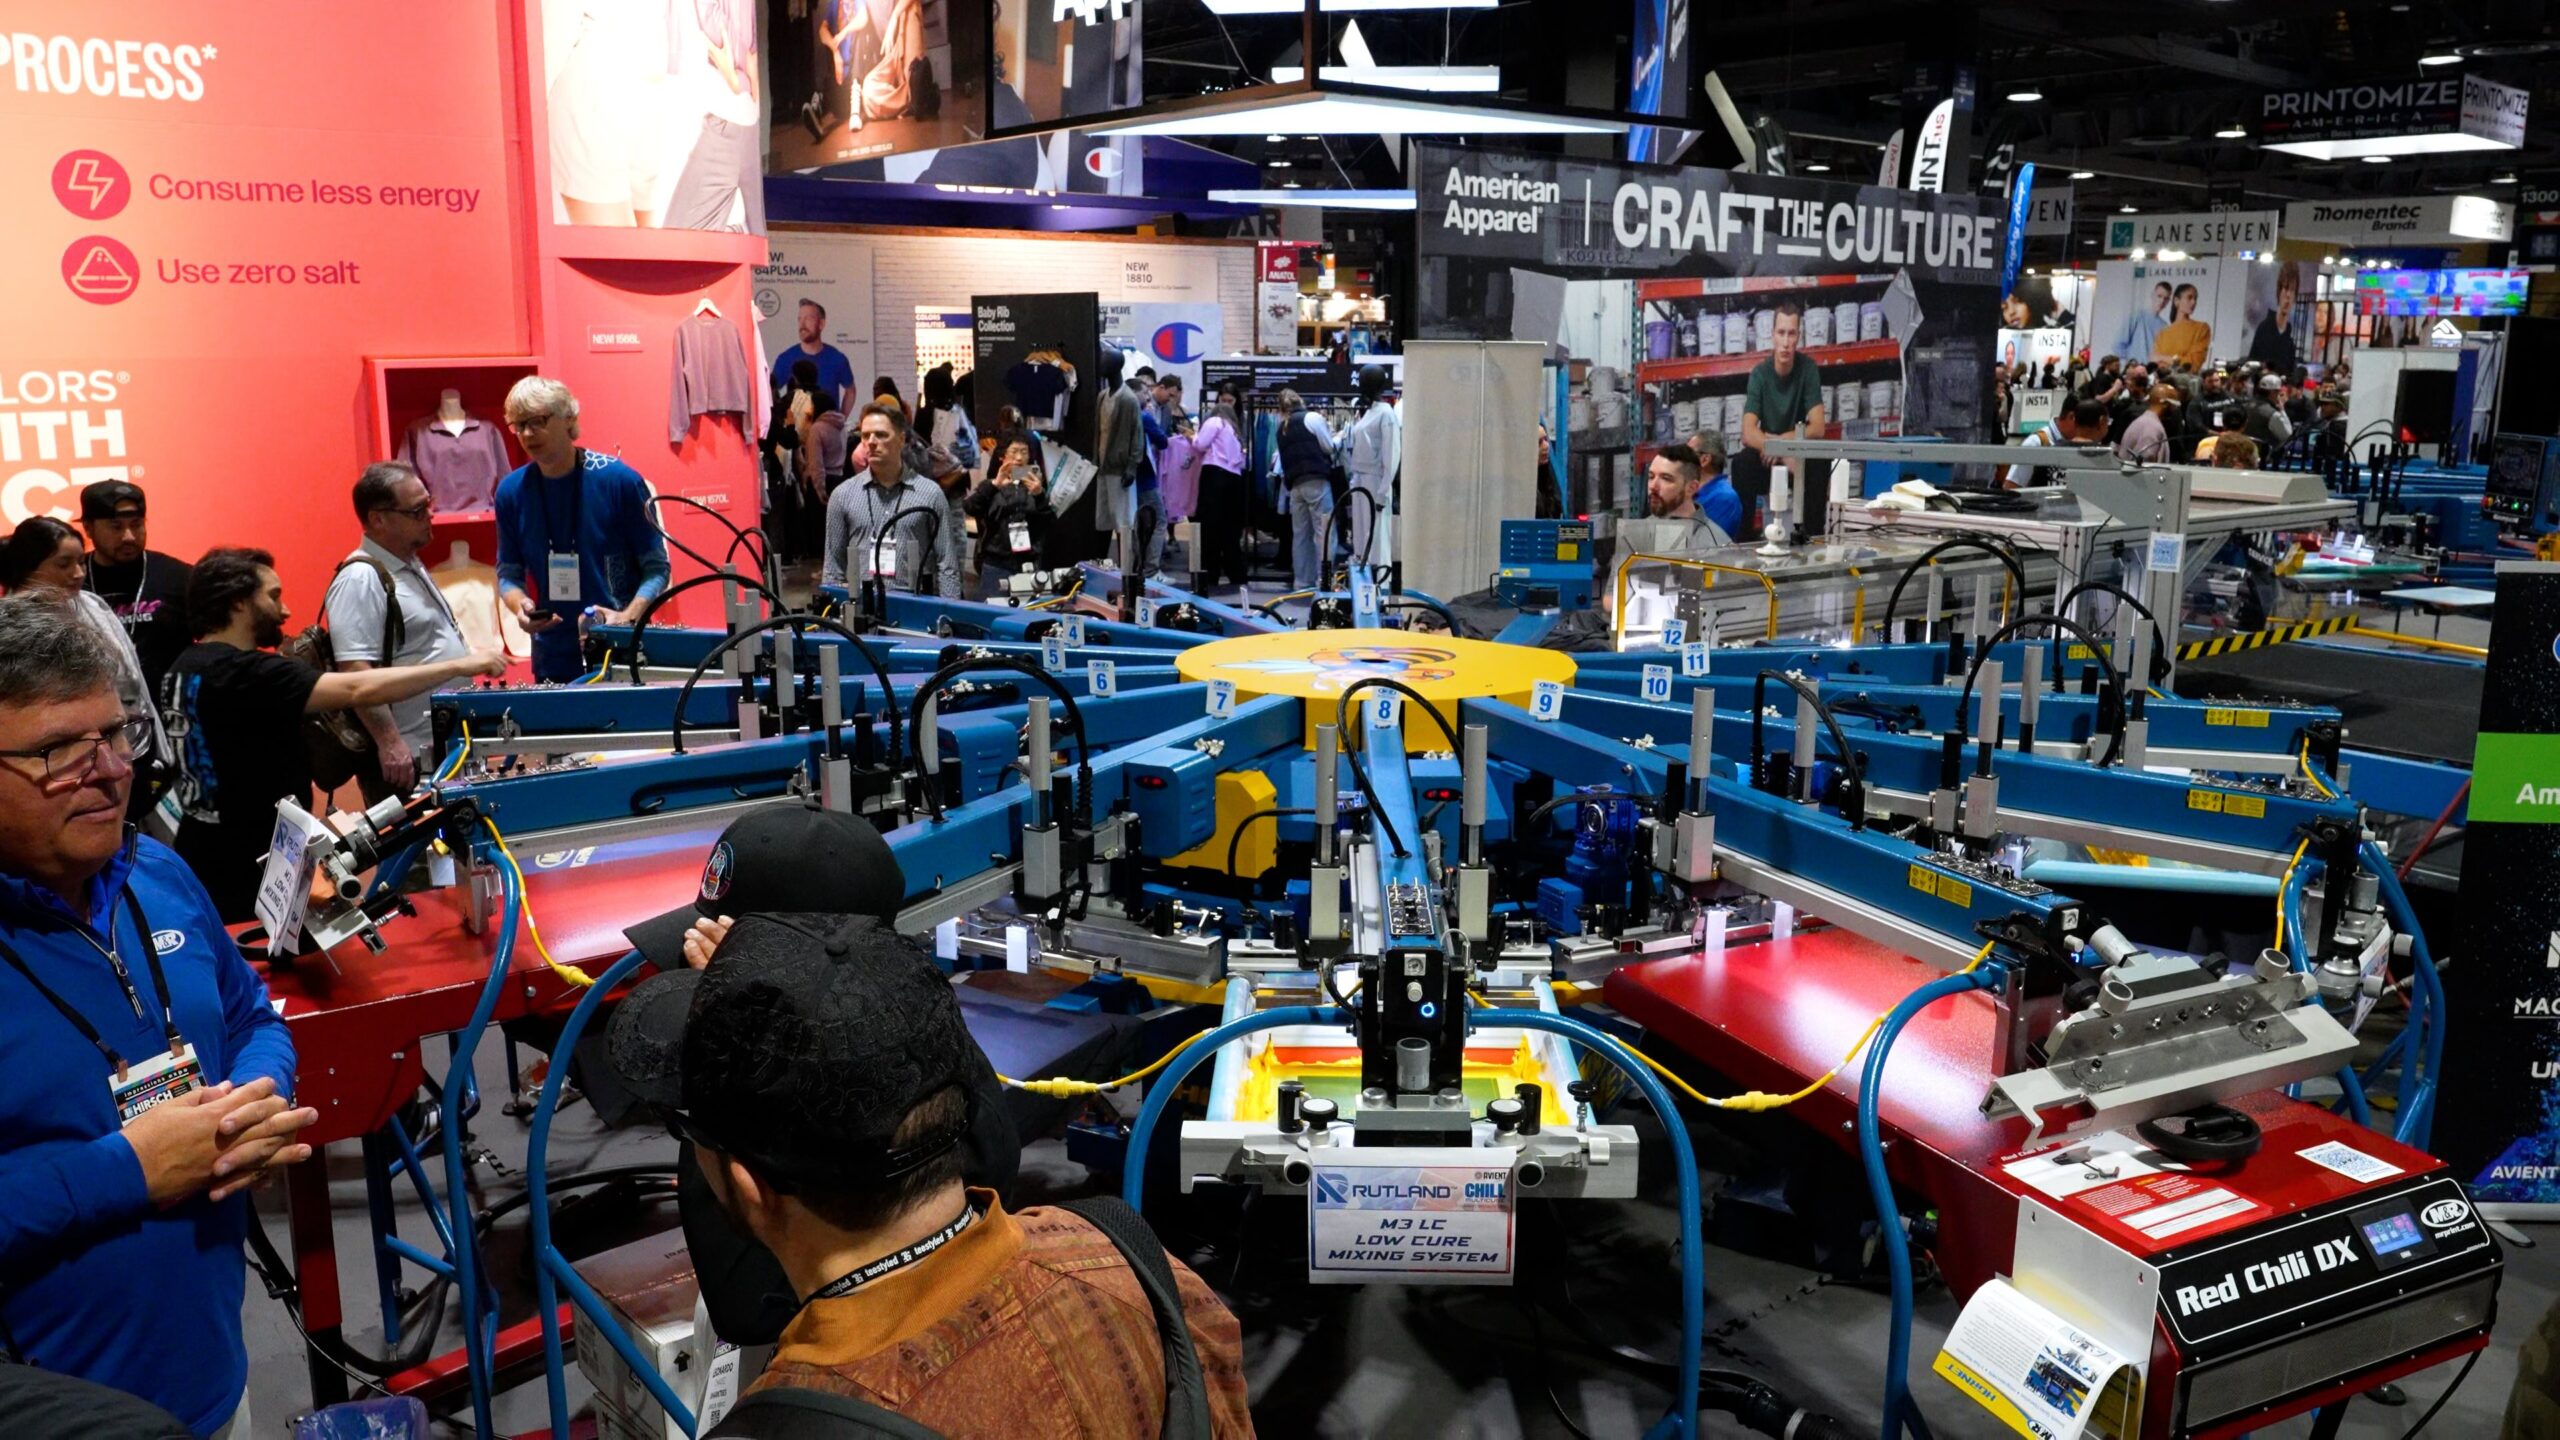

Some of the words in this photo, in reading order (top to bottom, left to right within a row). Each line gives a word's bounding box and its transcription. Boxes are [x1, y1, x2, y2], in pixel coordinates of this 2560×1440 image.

[2263, 80, 2459, 117] PRINTOMIZE
[2464, 80, 2529, 117] PRINTOMIZE
[149, 174, 304, 203] Consume
[311, 179, 373, 204] less
[379, 186, 480, 213] energy
[1444, 167, 1560, 203] American
[2521, 190, 2559, 204] 1300
[1612, 183, 1774, 255] CRAFT
[1778, 199, 1824, 239] THE
[2371, 221, 2418, 232] Brands
[2143, 223, 2194, 243] LANE
[2203, 221, 2271, 243] SEVEN
[157, 259, 220, 283] Use
[228, 263, 295, 284] zero
[304, 260, 360, 284] salt
[1126, 262, 1149, 271] NEW!
[2150, 267, 2172, 277] LANE
[2176, 267, 2208, 277] SEVEN
[1126, 273, 1153, 283] 18810
[978, 306, 996, 319] Baby
[997, 306, 1010, 318] Rib
[978, 320, 1015, 332] Collection
[1140, 608, 1148, 622] 3
[1069, 627, 1077, 641] 4
[1664, 629, 1681, 645] 12
[1049, 650, 1058, 664] 5
[1687, 653, 1704, 670] 11
[1096, 673, 1107, 690] 6
[1647, 677, 1667, 695] 10
[1216, 691, 1227, 710] 7
[1539, 695, 1552, 713] 9
[1378, 700, 1391, 719] 8
[168, 1067, 189, 1080] expo
[133, 1089, 173, 1115] HIRSCH
[2491, 1166, 2558, 1179] AVIENT
[1464, 1183, 1506, 1198] CHILL
[1380, 1218, 1413, 1230] M3
[1419, 1219, 1447, 1230] LC
[2435, 1221, 2475, 1239] mrprint.com
[1355, 1235, 1405, 1246] LOW
[1410, 1236, 1472, 1247] CURE
[864, 1255, 899, 1278] teestyled
[913, 1233, 944, 1256] teestyled
[1328, 1250, 1404, 1261] MIXING
[1410, 1252, 1498, 1263] SYSTEM
[2176, 1273, 2240, 1316] Red
[2244, 1251, 2311, 1294] Chili
[2313, 1236, 2359, 1272] DX
[1945, 1363, 1997, 1402] HORNET
